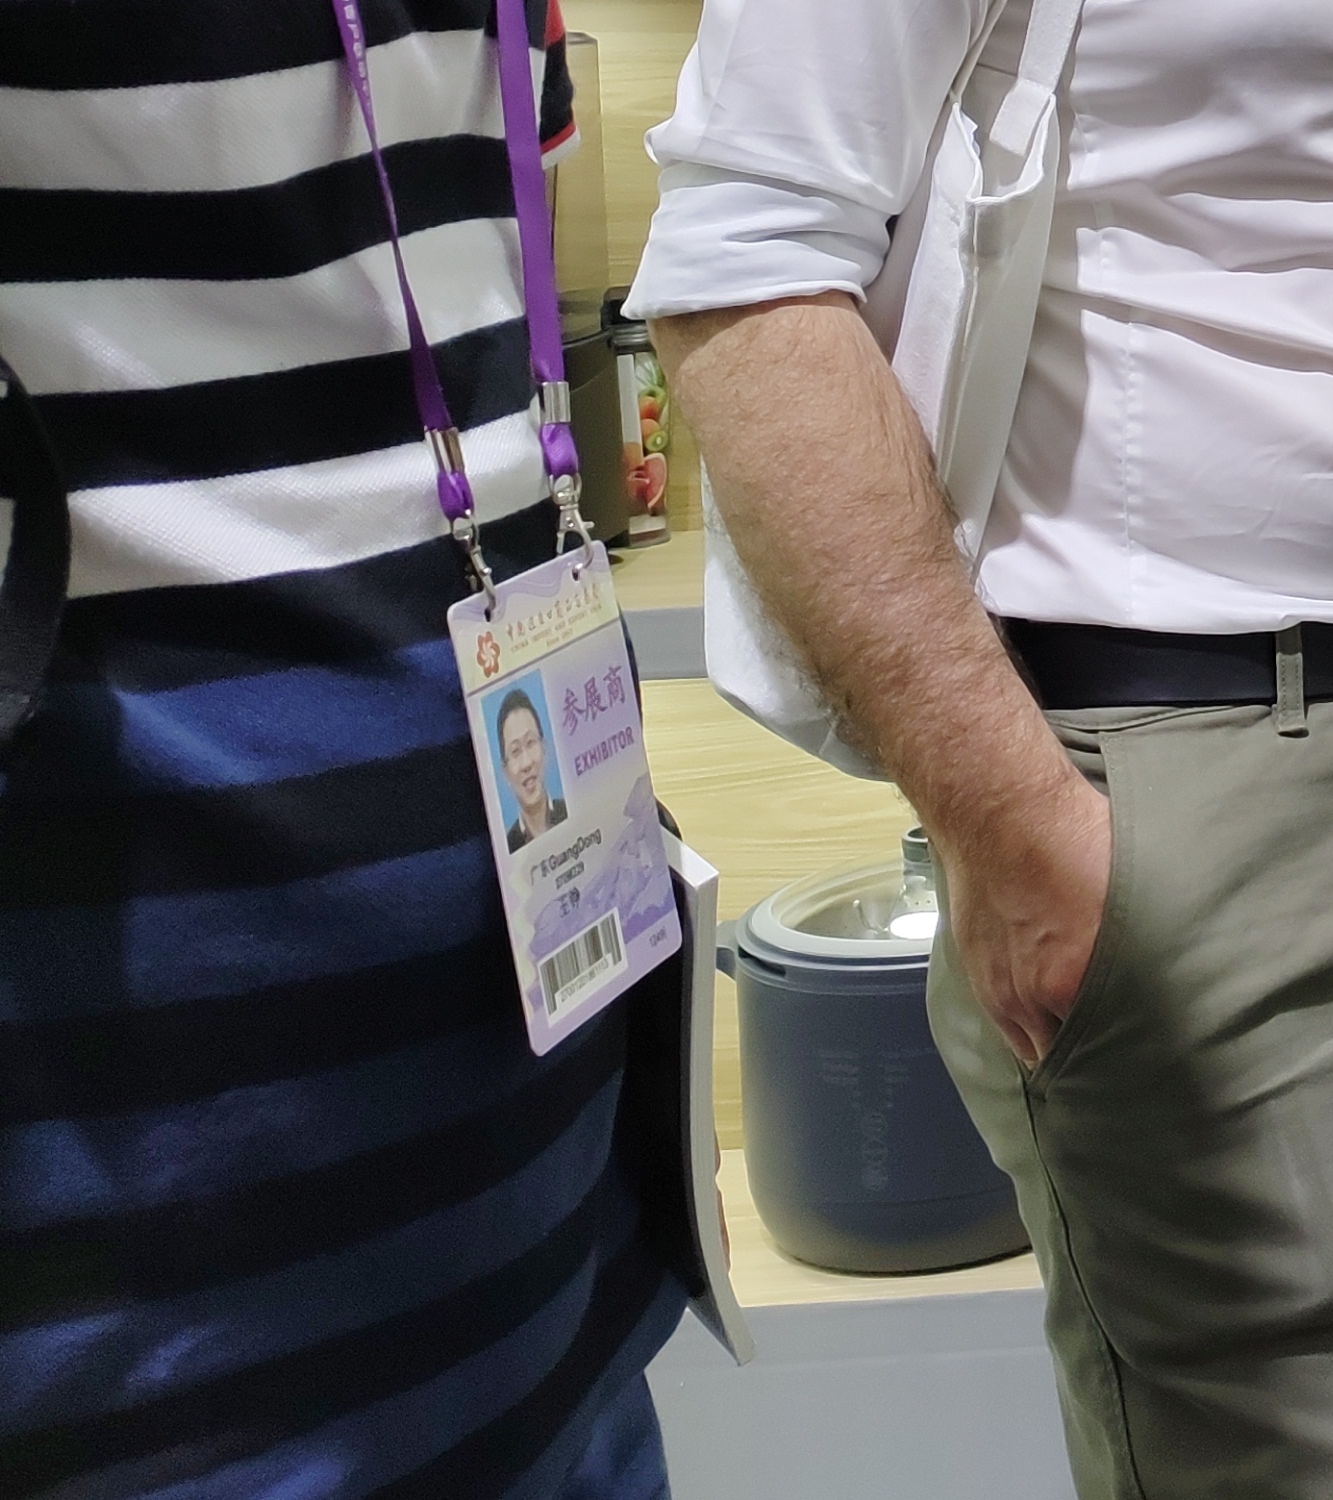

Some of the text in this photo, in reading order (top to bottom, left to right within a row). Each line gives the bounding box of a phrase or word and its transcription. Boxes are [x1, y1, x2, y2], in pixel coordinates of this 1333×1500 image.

[562, 665, 626, 736] 参展商
[575, 727, 634, 777] EXHIBITOR
